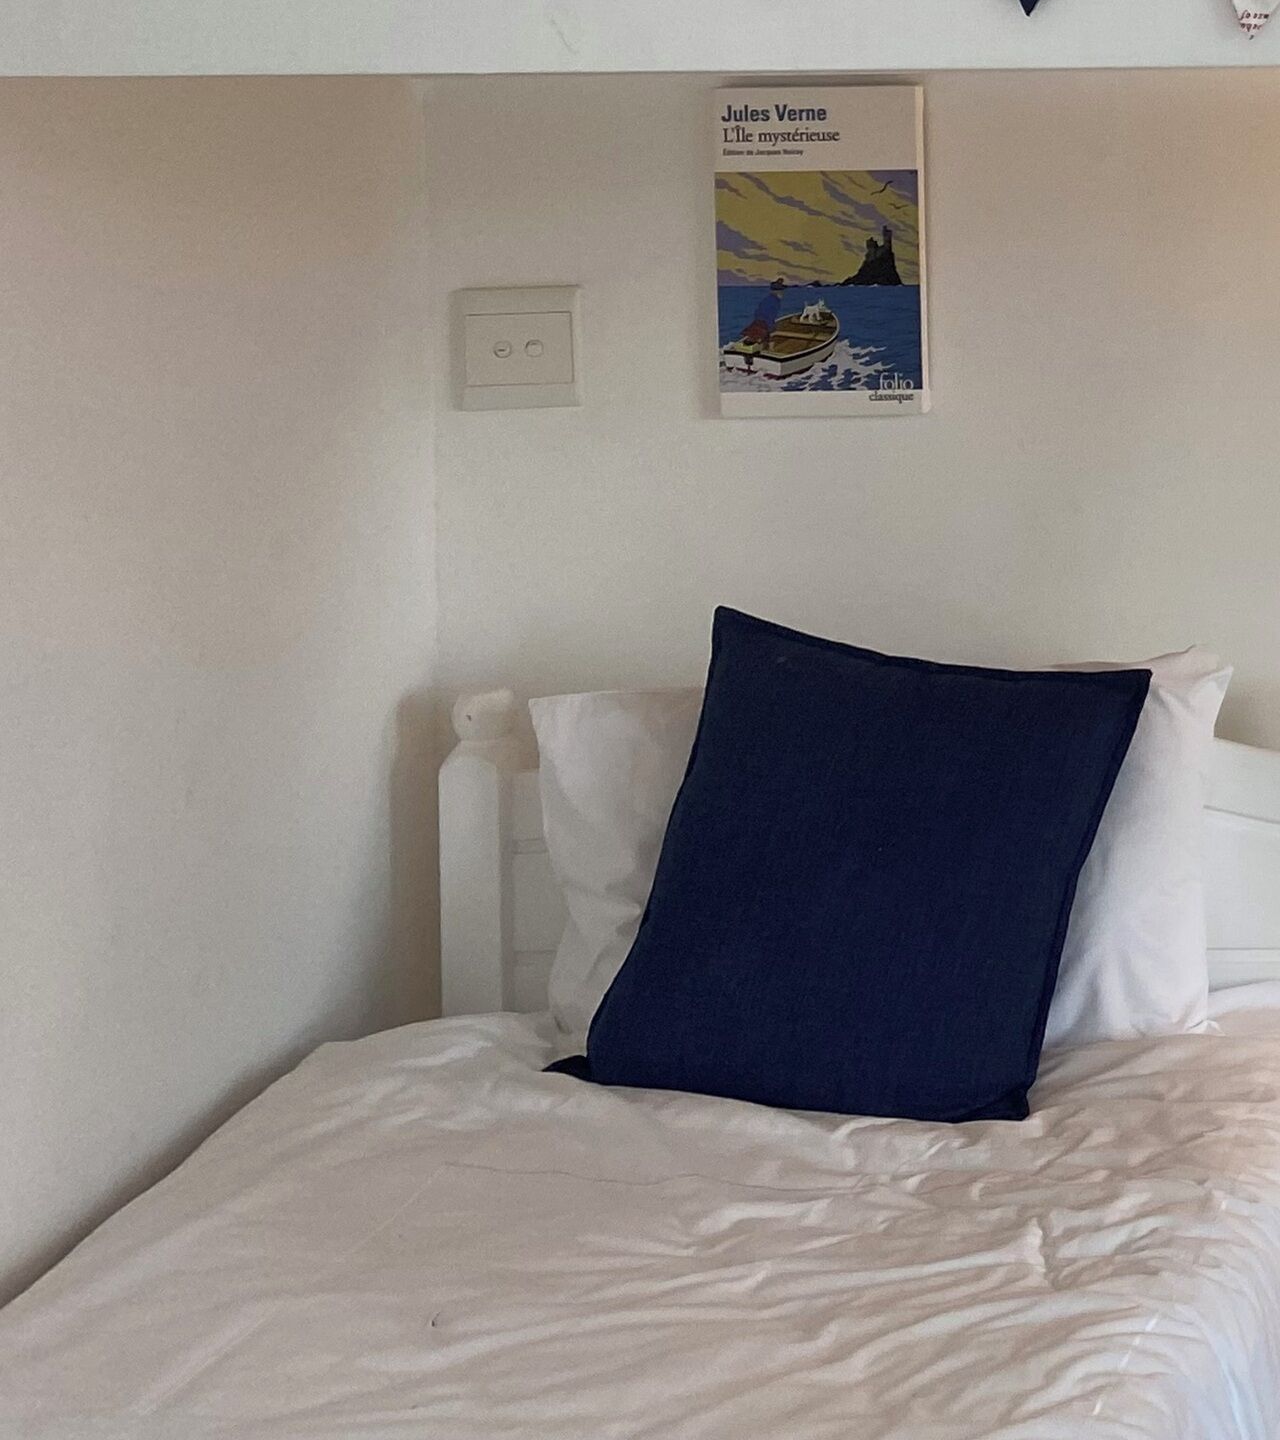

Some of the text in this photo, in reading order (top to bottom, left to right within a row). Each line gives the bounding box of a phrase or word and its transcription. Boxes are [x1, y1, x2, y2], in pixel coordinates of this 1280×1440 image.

[721, 103, 827, 122] Jules Verne
[723, 125, 841, 147] L'Île mystérieuse
[880, 372, 914, 391] folio
[869, 390, 914, 405] classique
